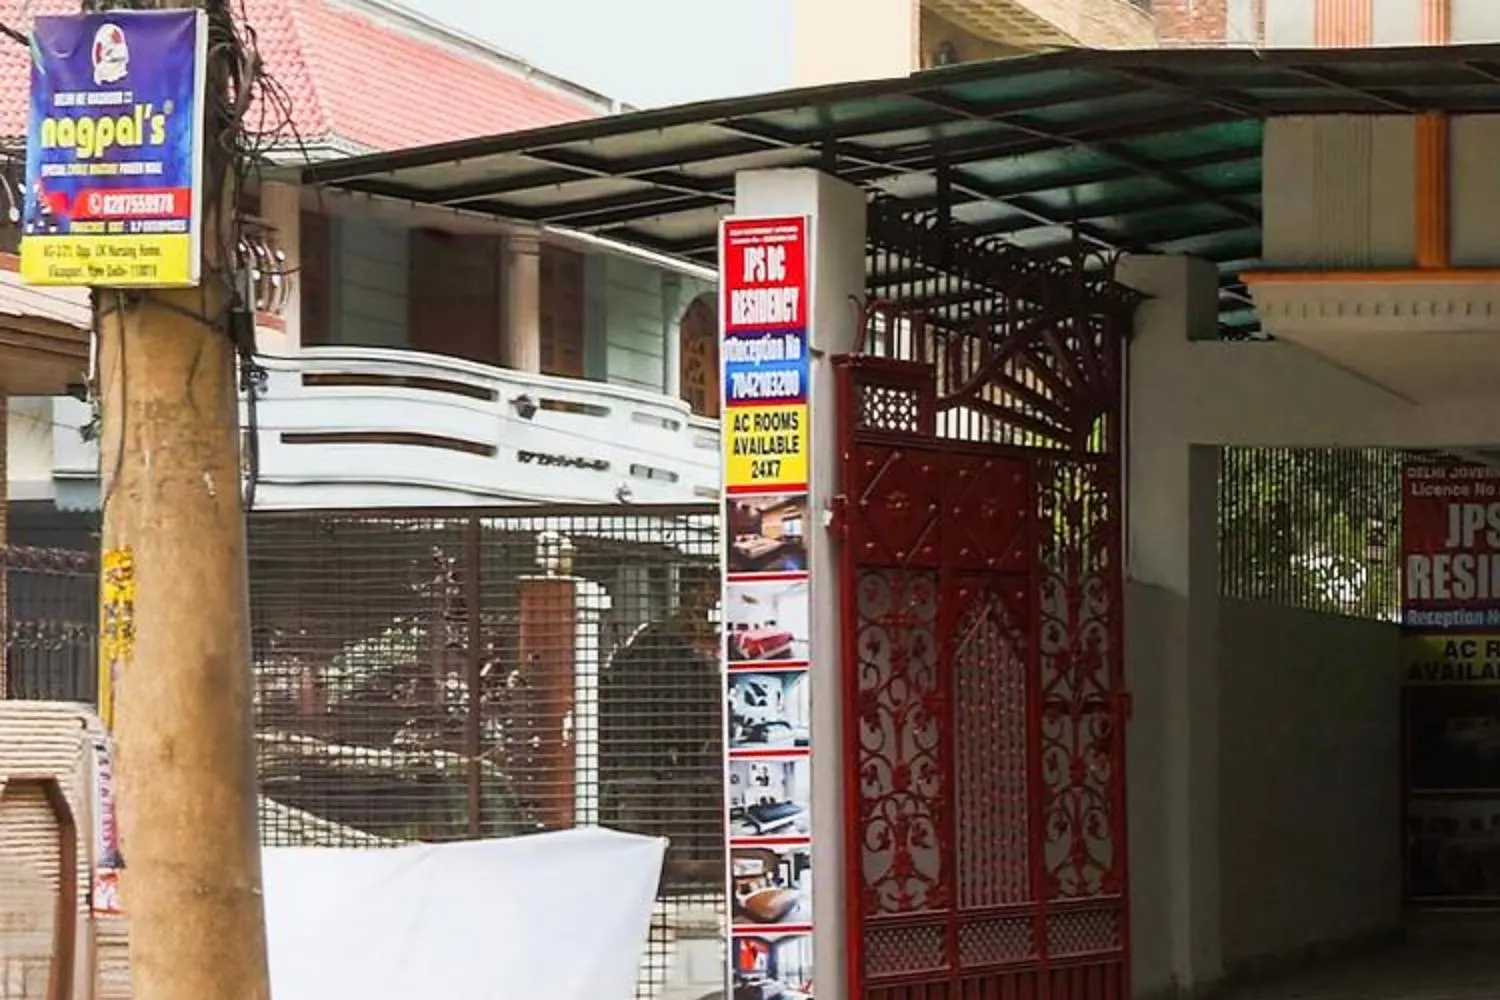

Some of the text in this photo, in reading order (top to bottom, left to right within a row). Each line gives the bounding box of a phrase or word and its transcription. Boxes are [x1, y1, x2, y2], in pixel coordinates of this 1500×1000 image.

[41, 104, 166, 158] nagpal's
[743, 246, 767, 282] JPS
[731, 287, 799, 325] RESIDENCY
[734, 411, 799, 433] AC ROOMS
[733, 435, 800, 455] AVAILABLE
[751, 460, 781, 479] 24X7
[1411, 482, 1469, 497] Licence
[1407, 609, 1484, 628] Reception
[1444, 640, 1478, 659] AC
